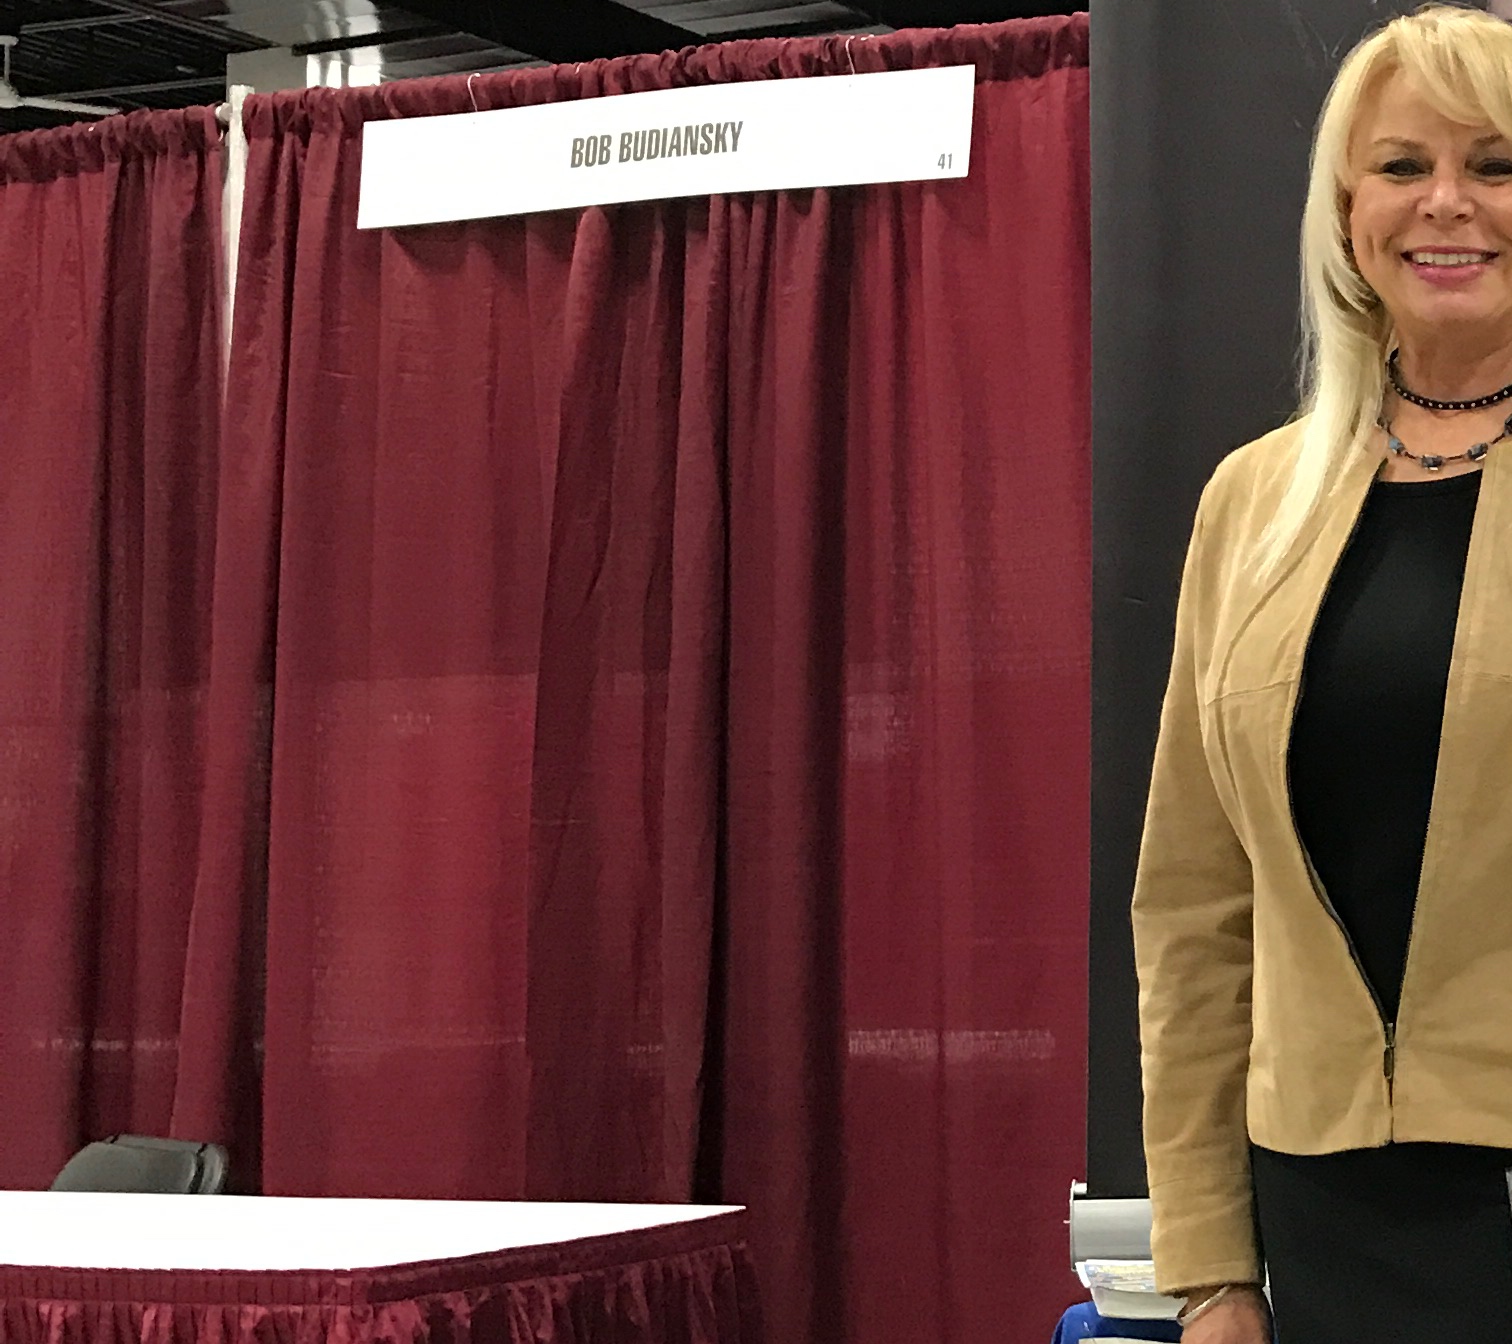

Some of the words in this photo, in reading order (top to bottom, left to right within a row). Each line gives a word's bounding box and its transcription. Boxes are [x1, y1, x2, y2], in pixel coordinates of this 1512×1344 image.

[571, 134, 612, 168] BOB
[618, 121, 744, 163] BUDIANSKY
[937, 153, 953, 170] 41
